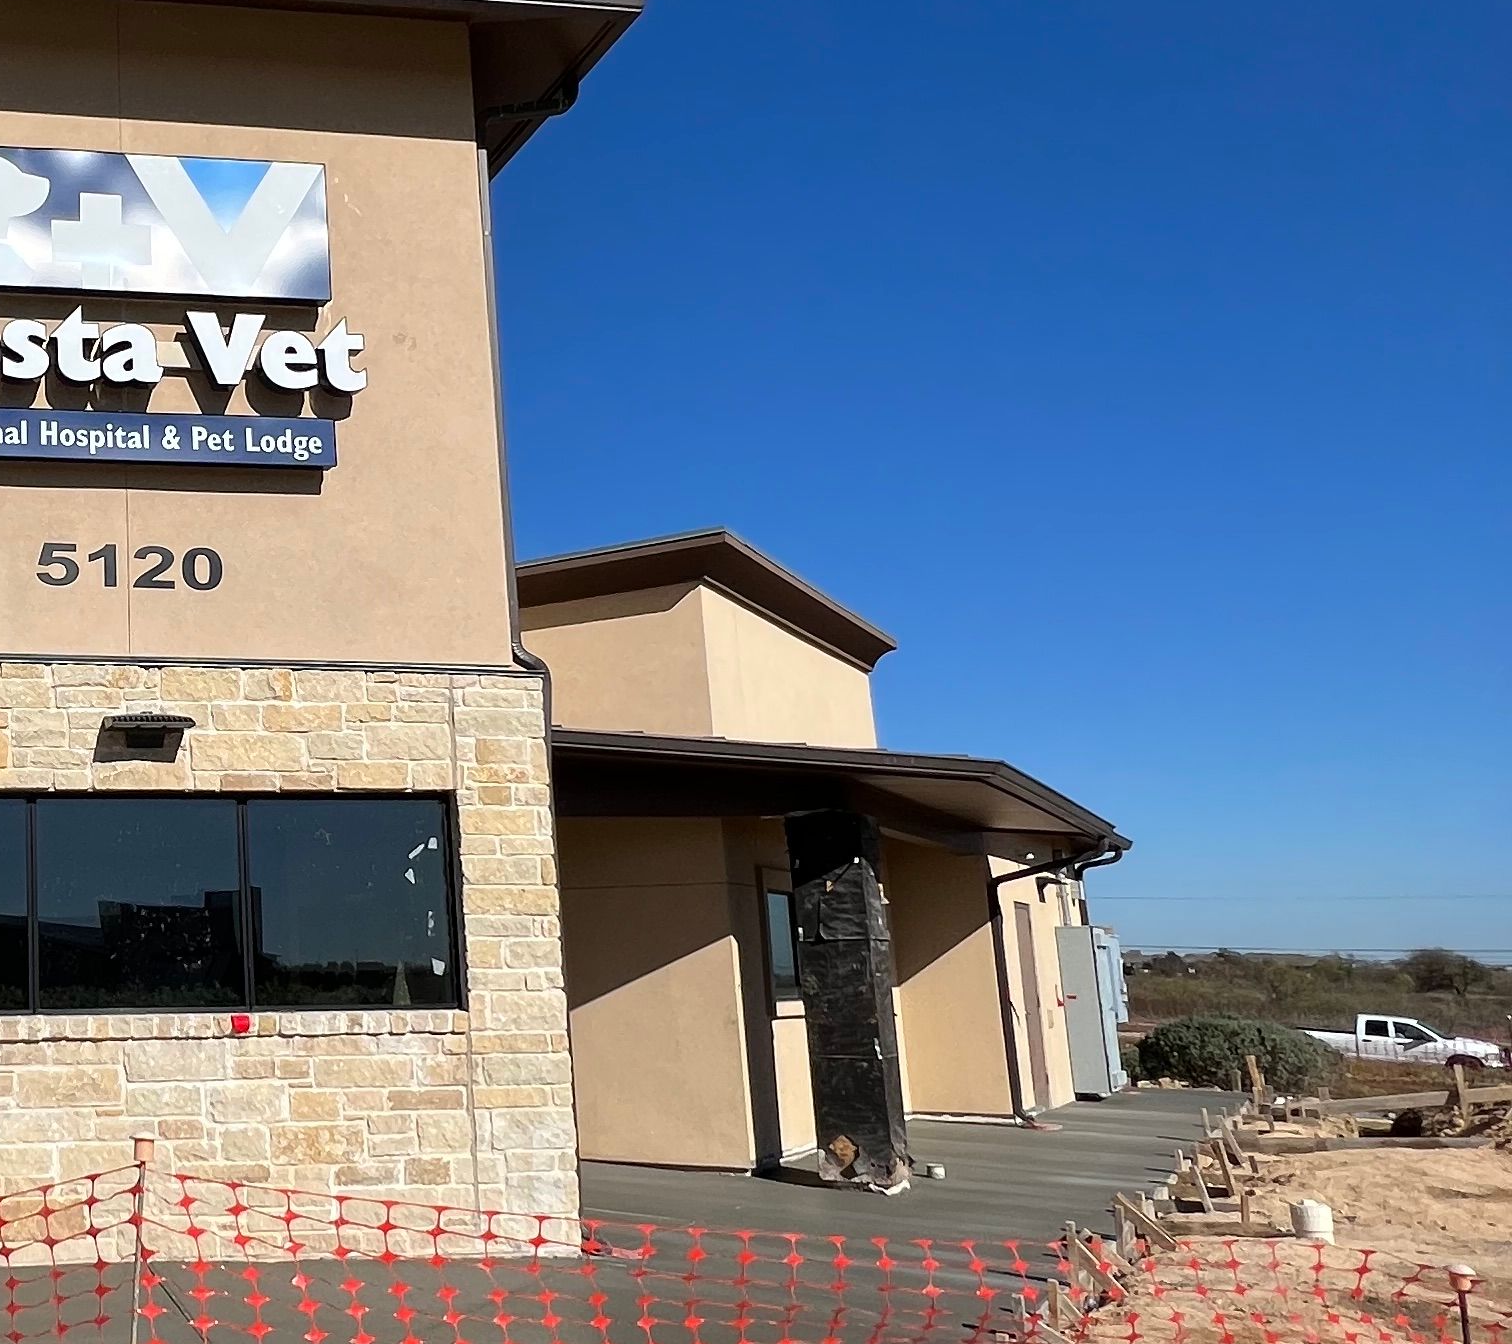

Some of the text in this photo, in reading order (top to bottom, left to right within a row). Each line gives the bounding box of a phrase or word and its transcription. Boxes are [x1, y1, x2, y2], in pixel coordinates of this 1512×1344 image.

[187, 310, 368, 393] Vet
[40, 420, 150, 455] Hospital
[161, 425, 181, 451] &
[192, 425, 235, 452] Pet
[245, 427, 323, 460] Lodge
[36, 542, 224, 591] 5120
